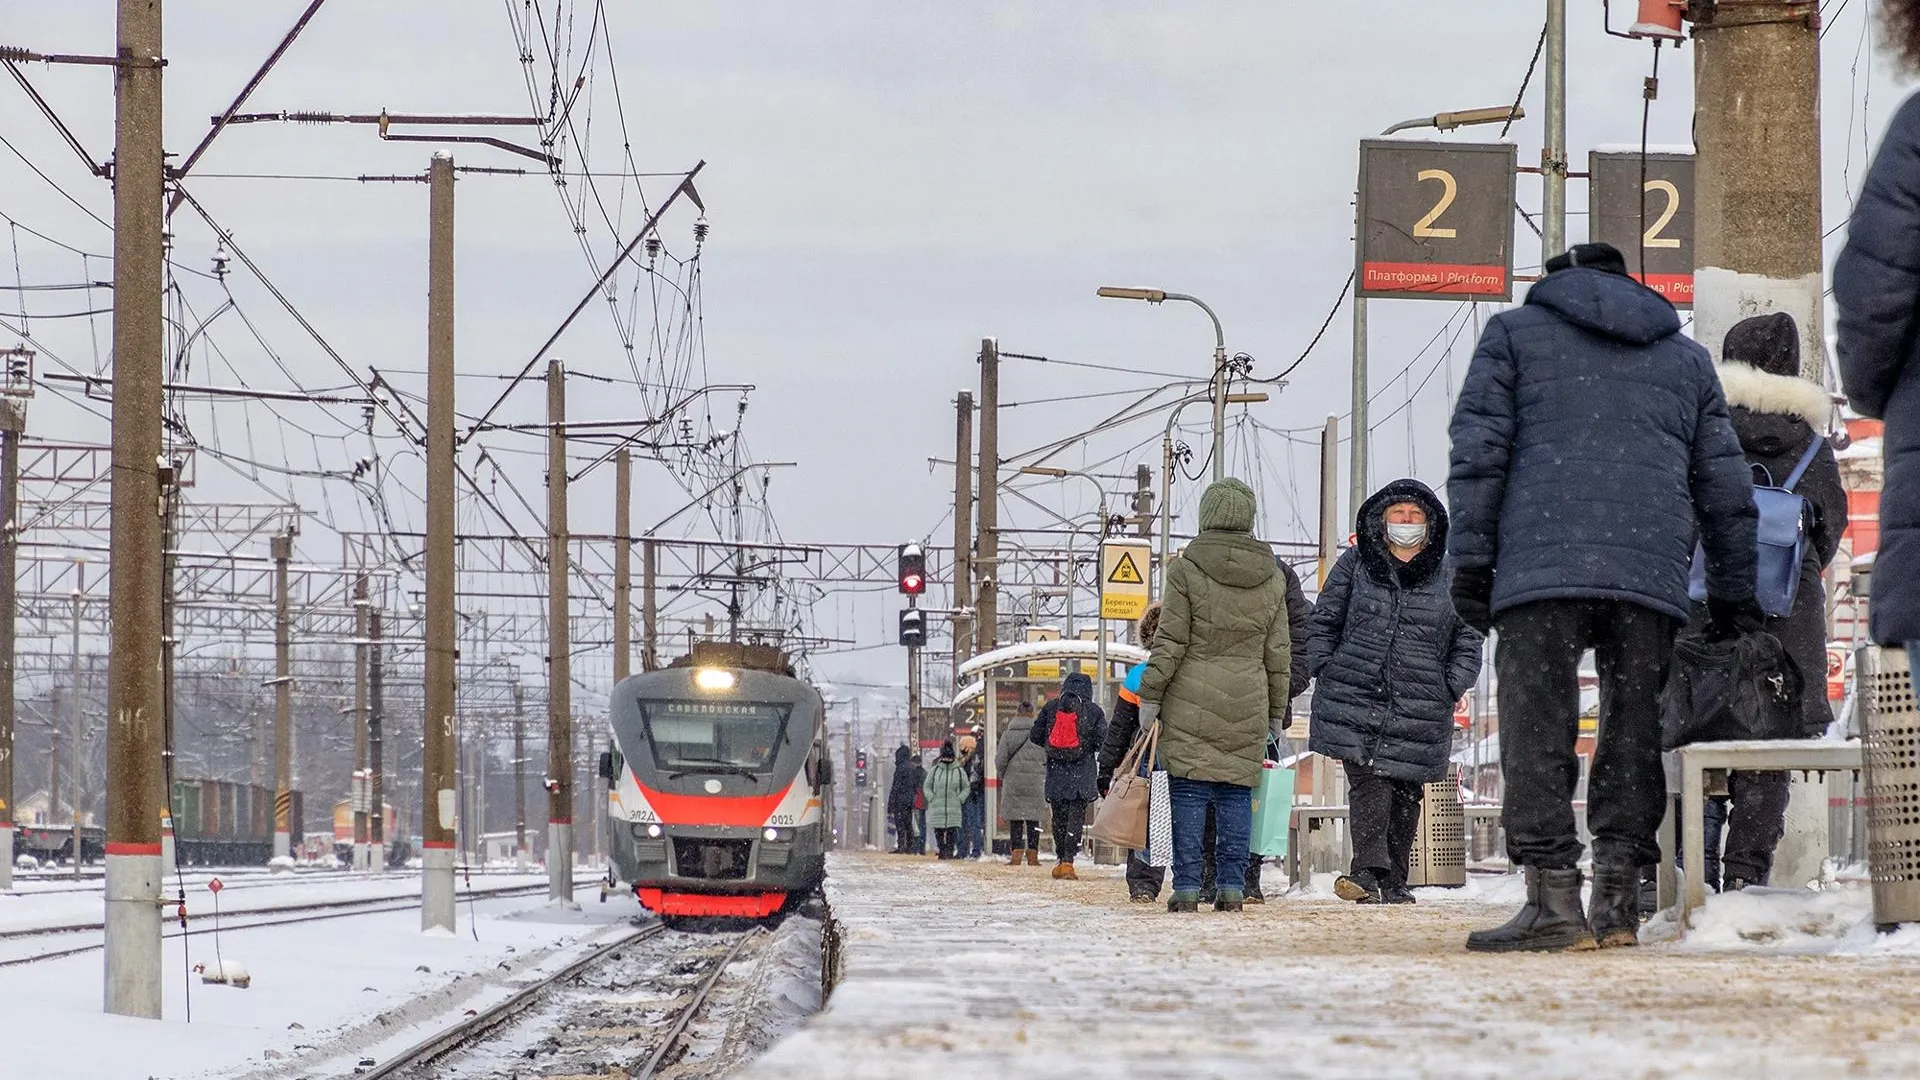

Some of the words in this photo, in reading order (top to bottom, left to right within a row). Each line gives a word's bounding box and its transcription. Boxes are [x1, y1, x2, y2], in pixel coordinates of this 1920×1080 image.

[1413, 169, 1457, 238] 2
[1643, 180, 1680, 248] 2
[1368, 270, 1438, 284] Платформа
[1447, 271, 1499, 285] Platform
[1104, 598, 1138, 607] Берегись
[965, 708, 976, 724] 2
[629, 810, 656, 822] ЭП2Д
[771, 814, 794, 825] 0025
